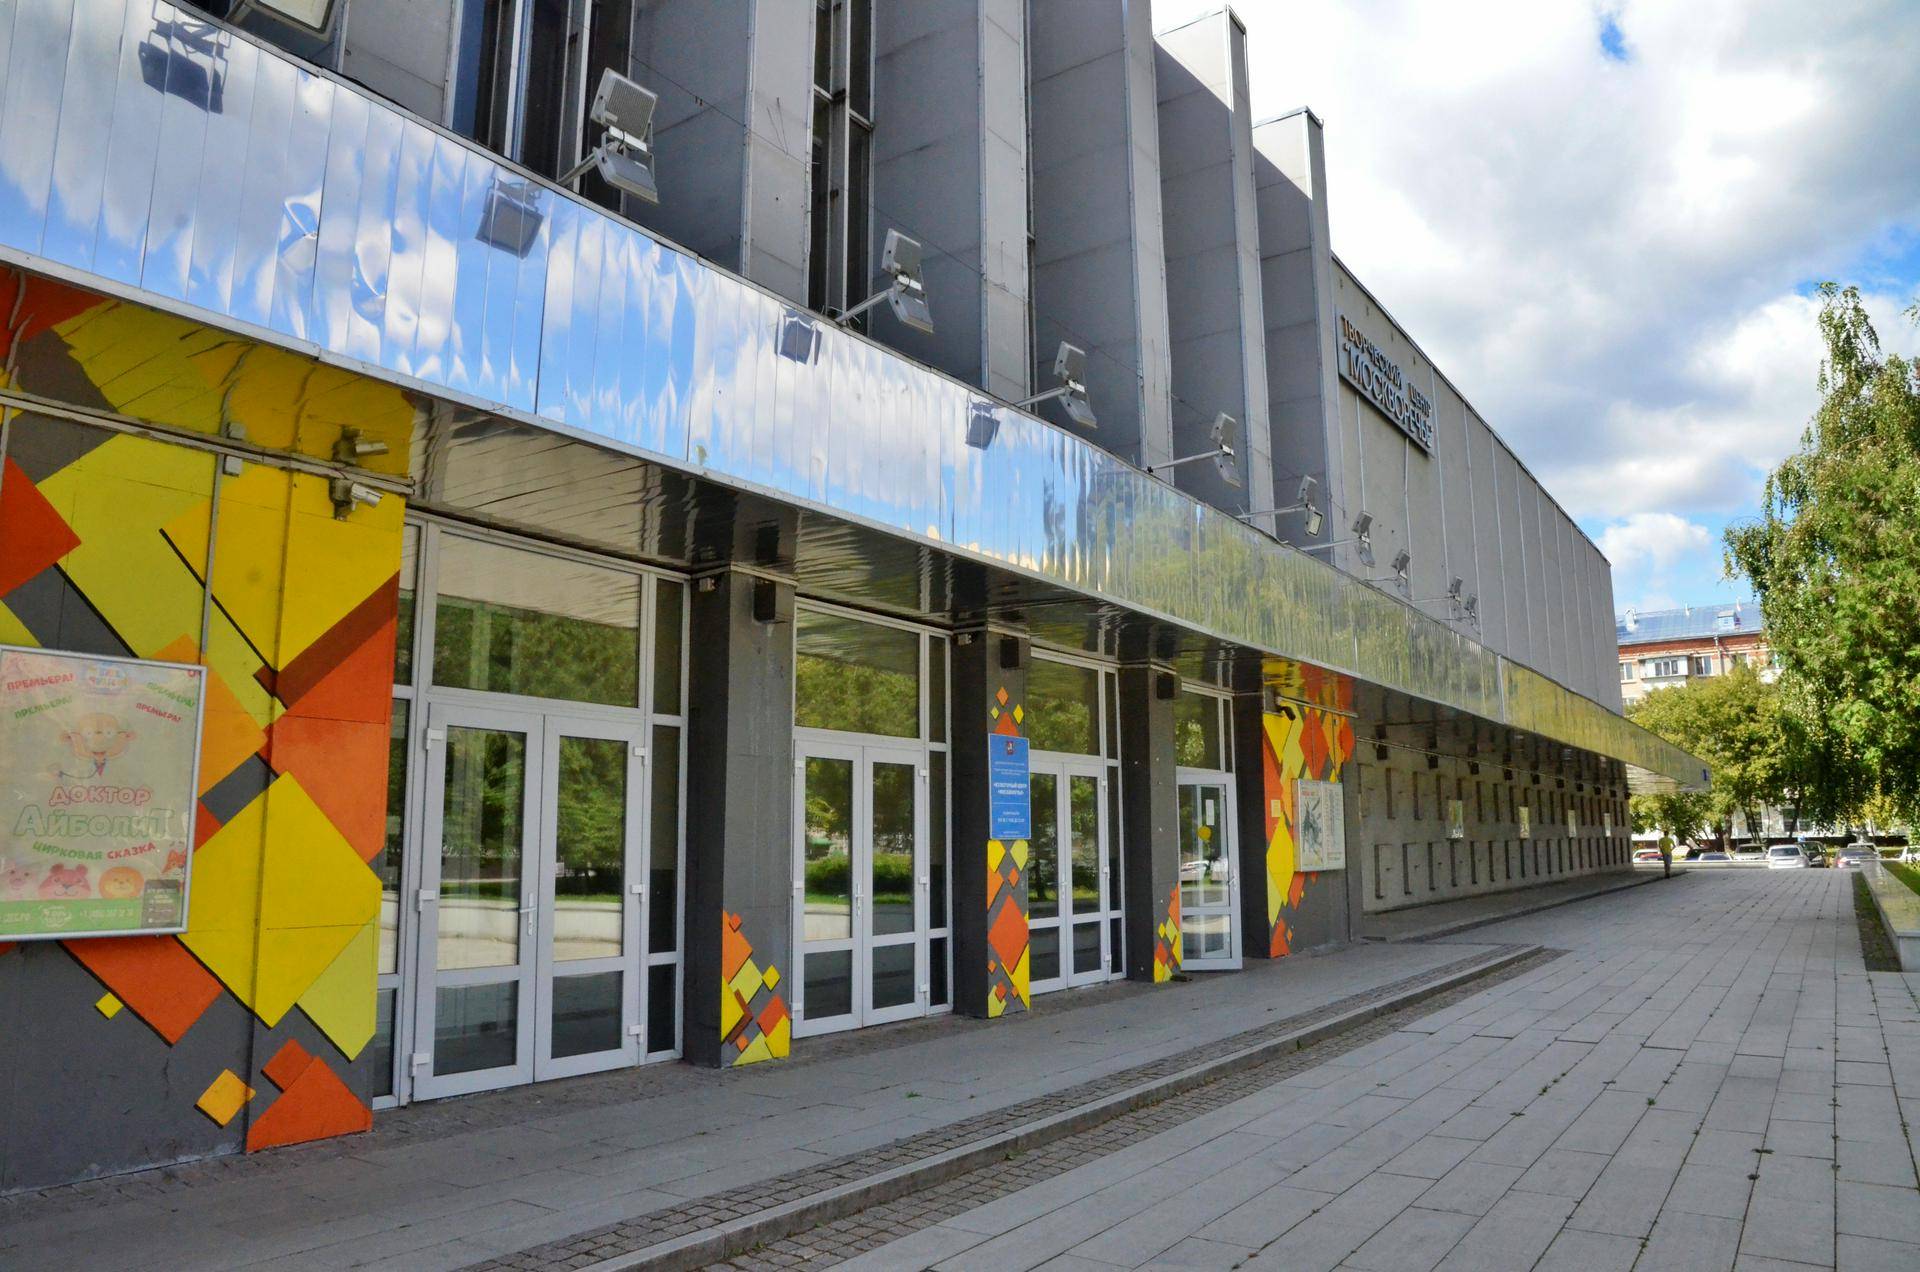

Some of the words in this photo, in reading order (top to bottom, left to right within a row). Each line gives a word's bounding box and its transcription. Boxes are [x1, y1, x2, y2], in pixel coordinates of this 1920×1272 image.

[7, 672, 74, 690] ПРЕМЬЕРА!
[49, 785, 152, 807] ДОКТОР
[32, 841, 104, 861] ЦИРКОВАЯ
[107, 842, 156, 860] СКАЗКА
